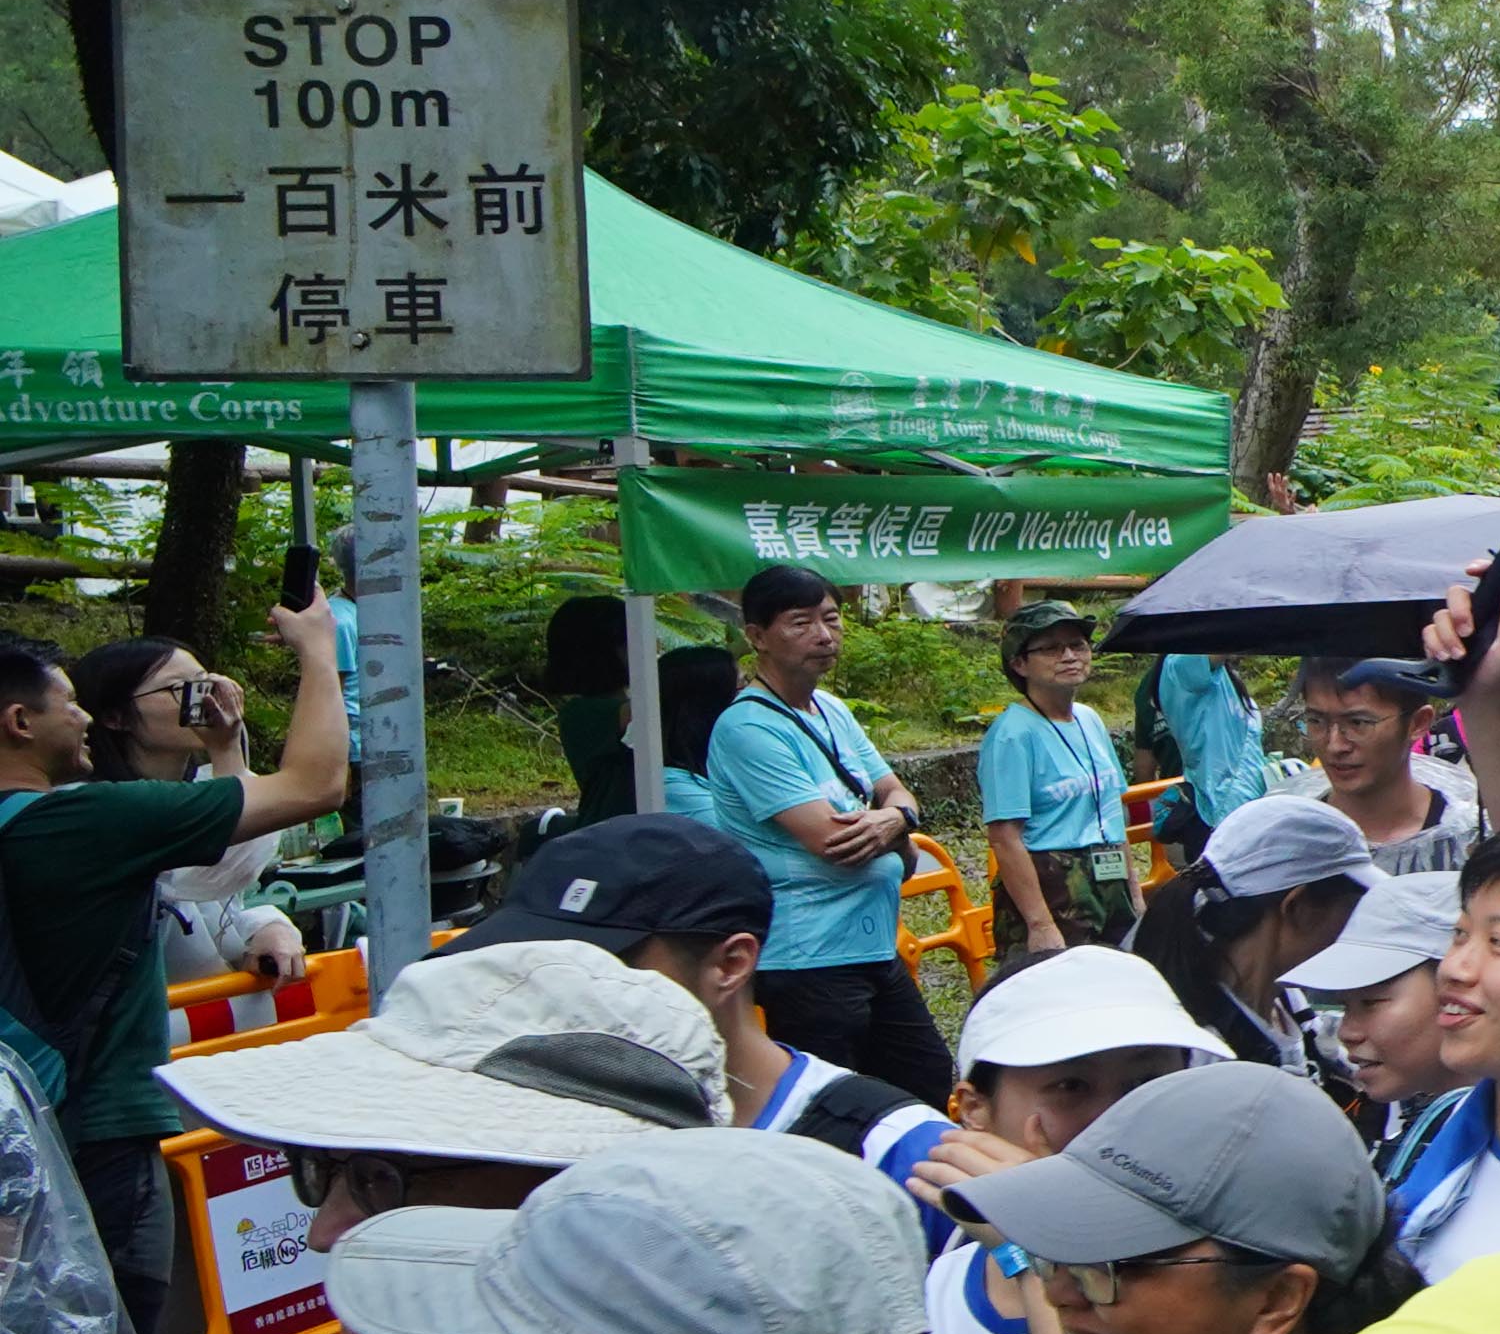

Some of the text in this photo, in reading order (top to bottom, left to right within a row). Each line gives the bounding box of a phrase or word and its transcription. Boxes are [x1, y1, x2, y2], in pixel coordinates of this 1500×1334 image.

[244, 15, 451, 68] STOP
[254, 79, 449, 128] 100m
[165, 164, 545, 236] 一百米前
[270, 272, 453, 346] 停車
[0, 391, 302, 429] dventure Corps
[888, 410, 939, 442] Hong
[943, 411, 989, 445] Kong
[994, 416, 1076, 446] Adventure
[743, 500, 953, 559] 嘉賓等候區
[967, 509, 1173, 558] VIP Waiting Area
[1112, 1153, 1180, 1200] Columbia
